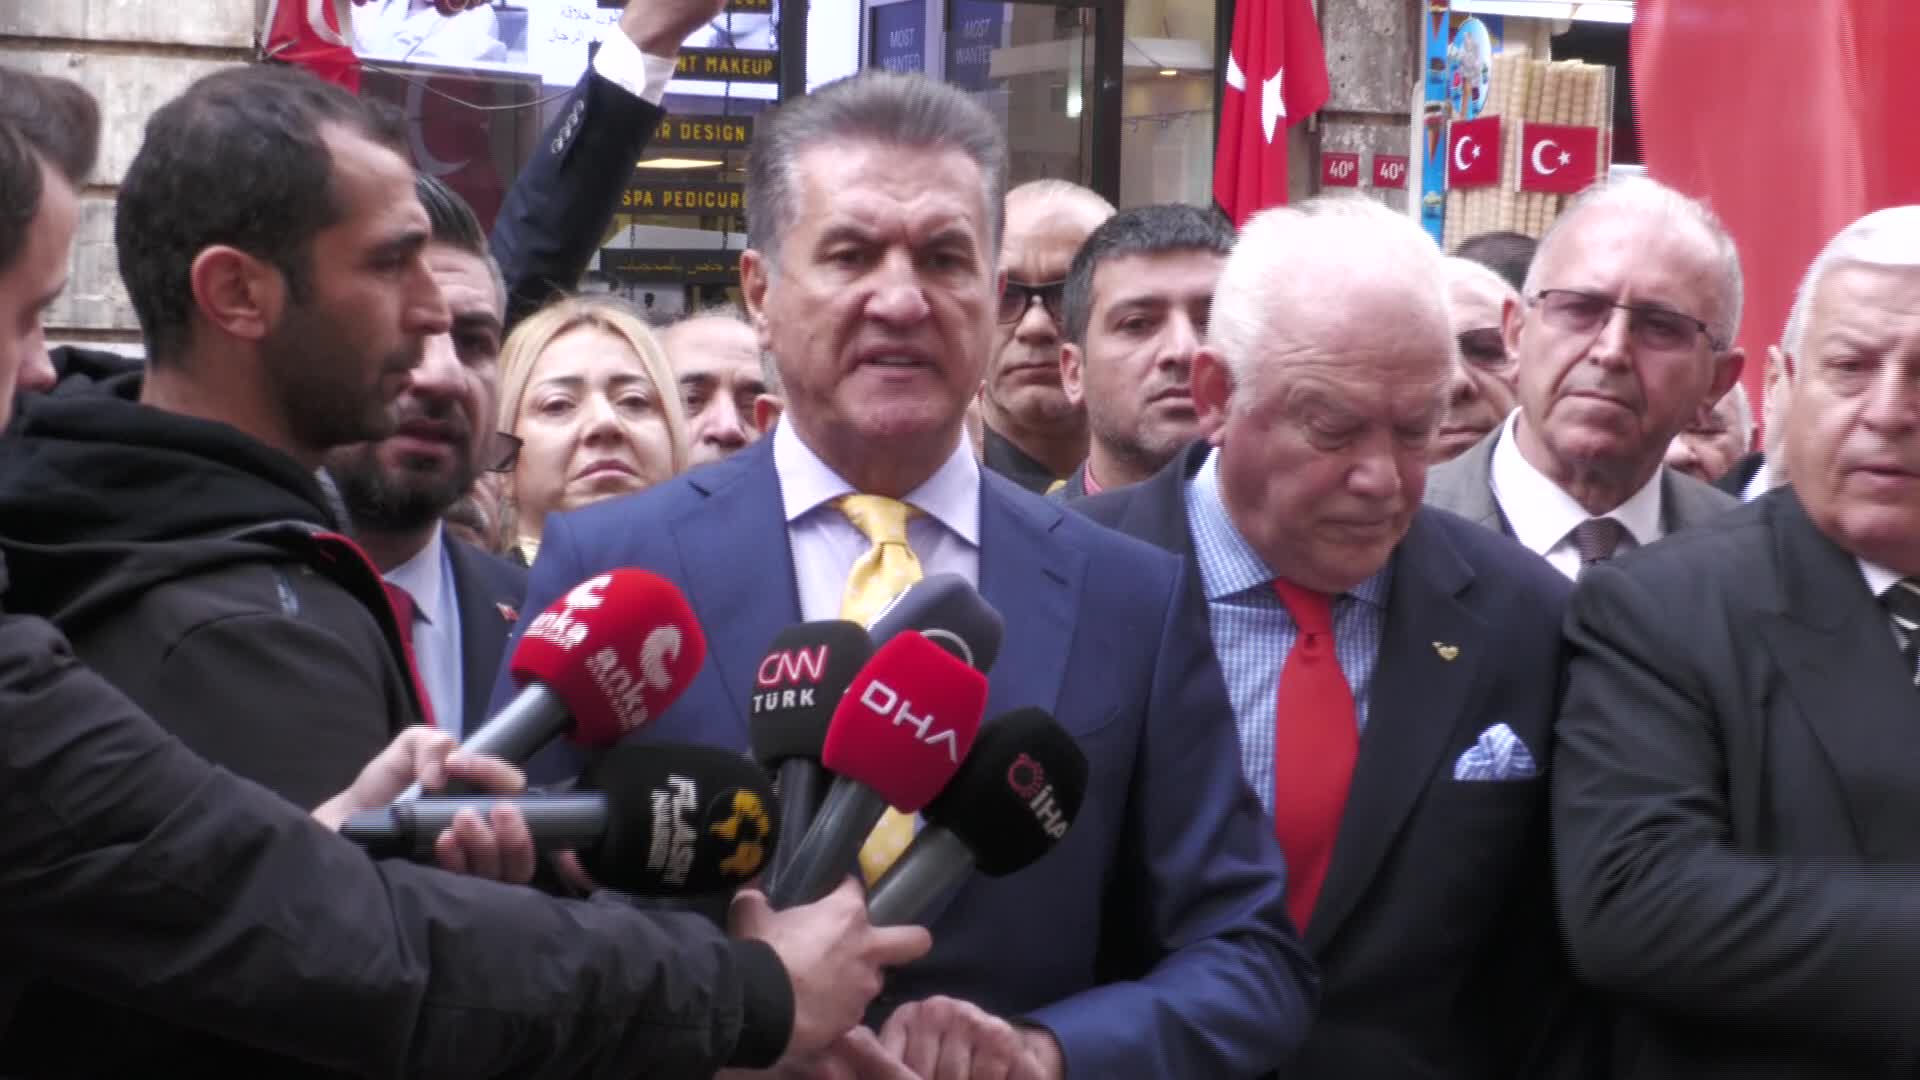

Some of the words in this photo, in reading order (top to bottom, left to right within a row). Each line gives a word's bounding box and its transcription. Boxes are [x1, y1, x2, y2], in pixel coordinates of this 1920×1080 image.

[889, 28, 915, 48] MOST
[705, 56, 774, 75] MAKEUP
[680, 123, 746, 142] DESIGN
[623, 190, 654, 206] SPA
[757, 644, 829, 686] CNN
[753, 687, 816, 713] TÜRK
[860, 679, 959, 763] DHA
